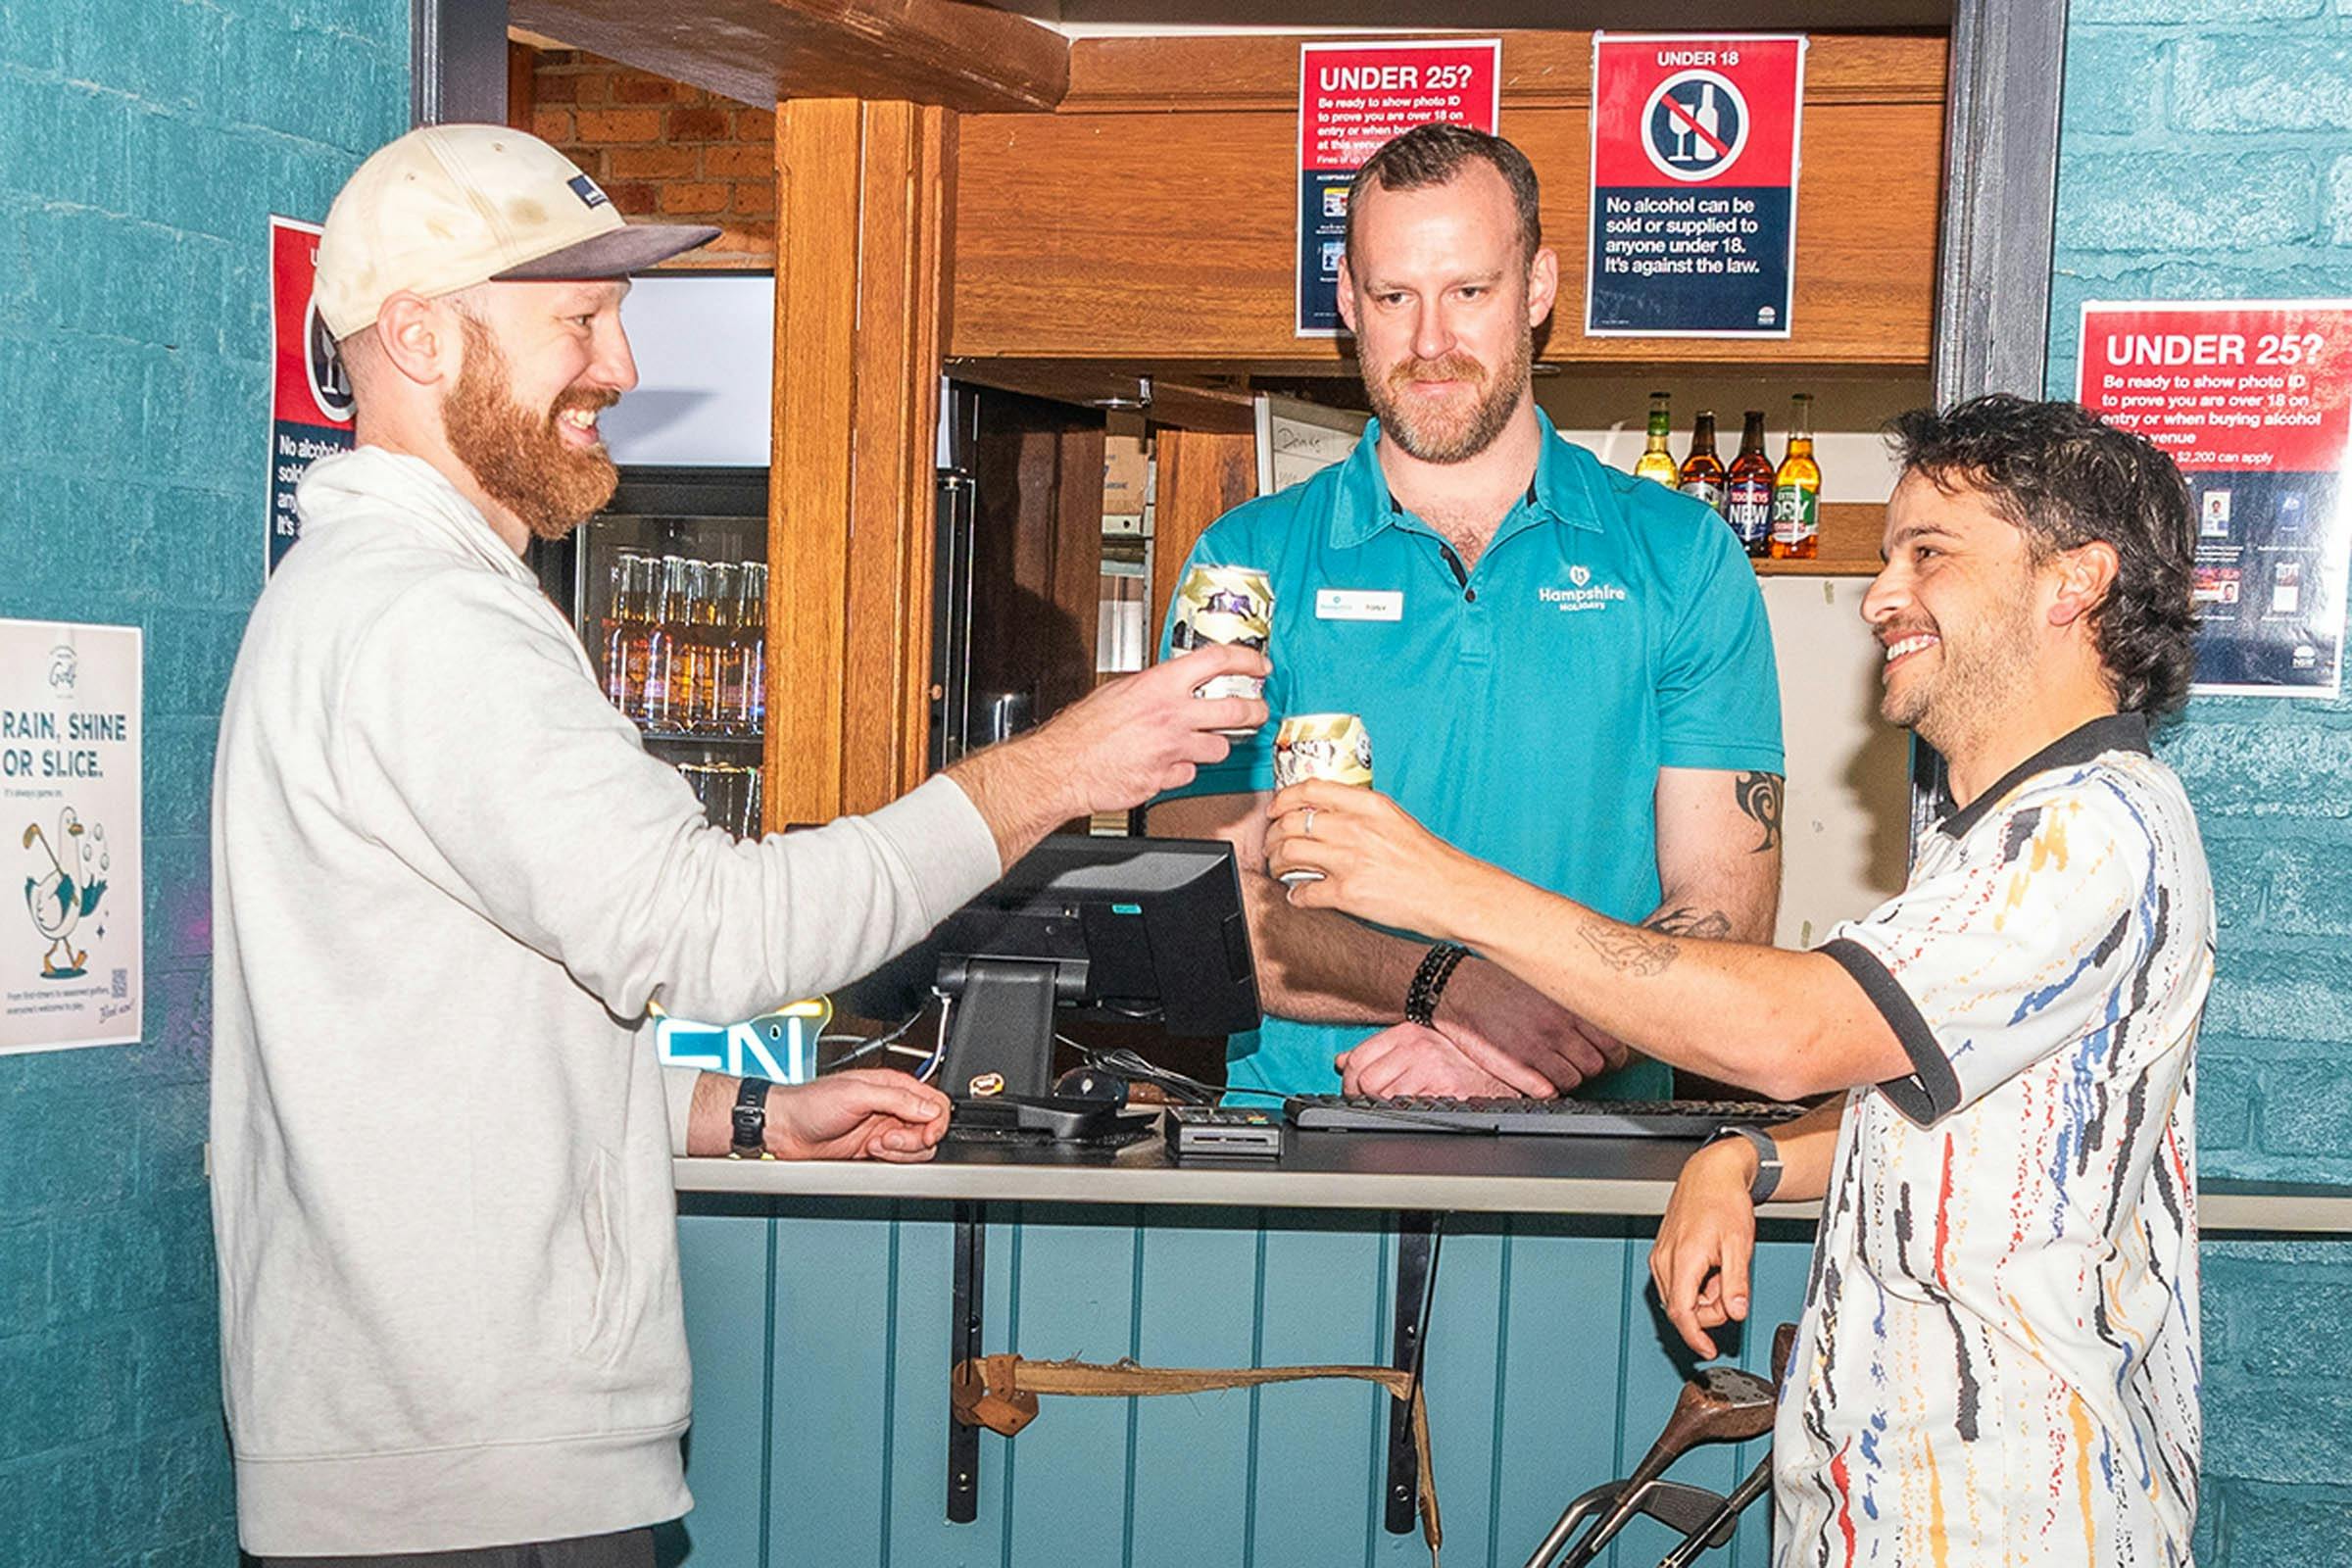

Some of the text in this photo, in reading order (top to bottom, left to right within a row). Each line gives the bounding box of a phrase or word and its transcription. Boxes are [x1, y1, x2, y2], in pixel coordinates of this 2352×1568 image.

[1656, 51, 1740, 67] UNDER 18
[1319, 64, 1473, 91] UNDER 25?
[1318, 95, 1461, 110] Be ready to show photo ID
[1317, 110, 1464, 124] to prove you are over 18 on
[1317, 125, 1345, 137] entry
[1347, 126, 1359, 135] or
[1361, 125, 1391, 134] when
[1316, 140, 1329, 150] at
[1606, 197, 1755, 214] No alcohol can be
[1605, 217, 1758, 236] sold or supplied to
[1604, 237, 1746, 256] anyone under 18.
[1604, 257, 1760, 276] It's against the law.
[2107, 333, 2325, 366] UNDER 25?
[2103, 374, 2306, 392] Be ready to show photo ID
[2101, 394, 2309, 410] to prove you are over 18 on
[2100, 412, 2322, 428] entry or when buying alcohol
[279, 434, 297, 457] No
[2150, 431, 2197, 444] venue
[2177, 451, 2216, 465] $2,200
[2218, 453, 2238, 464] can
[2241, 452, 2274, 466] apply
[276, 514, 295, 537] It's
[1539, 583, 1625, 602] Hampshire
[1559, 601, 1606, 612] HOLIDAYS
[3, 710, 126, 744] RAIN, SHINE
[3, 749, 104, 778] OR SLICE.
